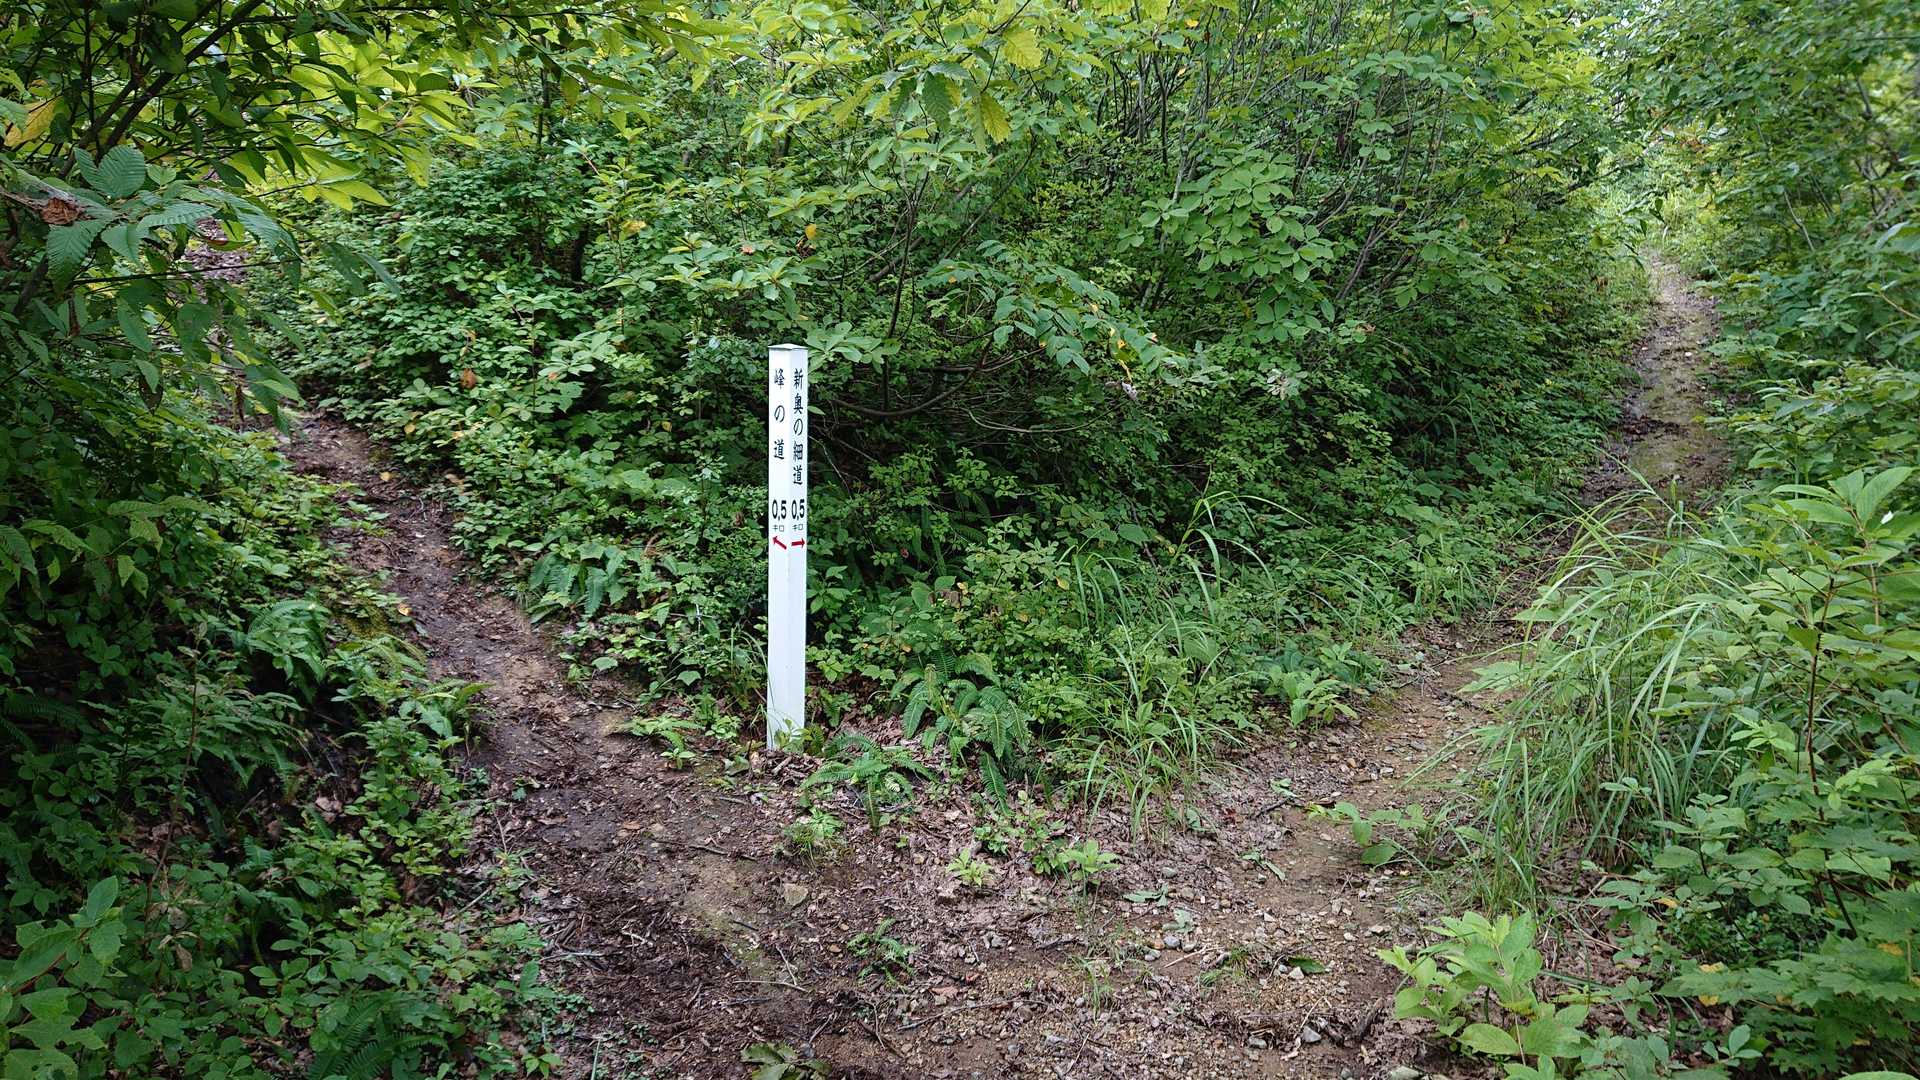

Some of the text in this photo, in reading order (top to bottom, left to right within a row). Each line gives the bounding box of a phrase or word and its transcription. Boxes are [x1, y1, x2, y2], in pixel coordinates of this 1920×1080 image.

[774, 368, 786, 460] 峰の道
[793, 368, 804, 486] 新奥の細道
